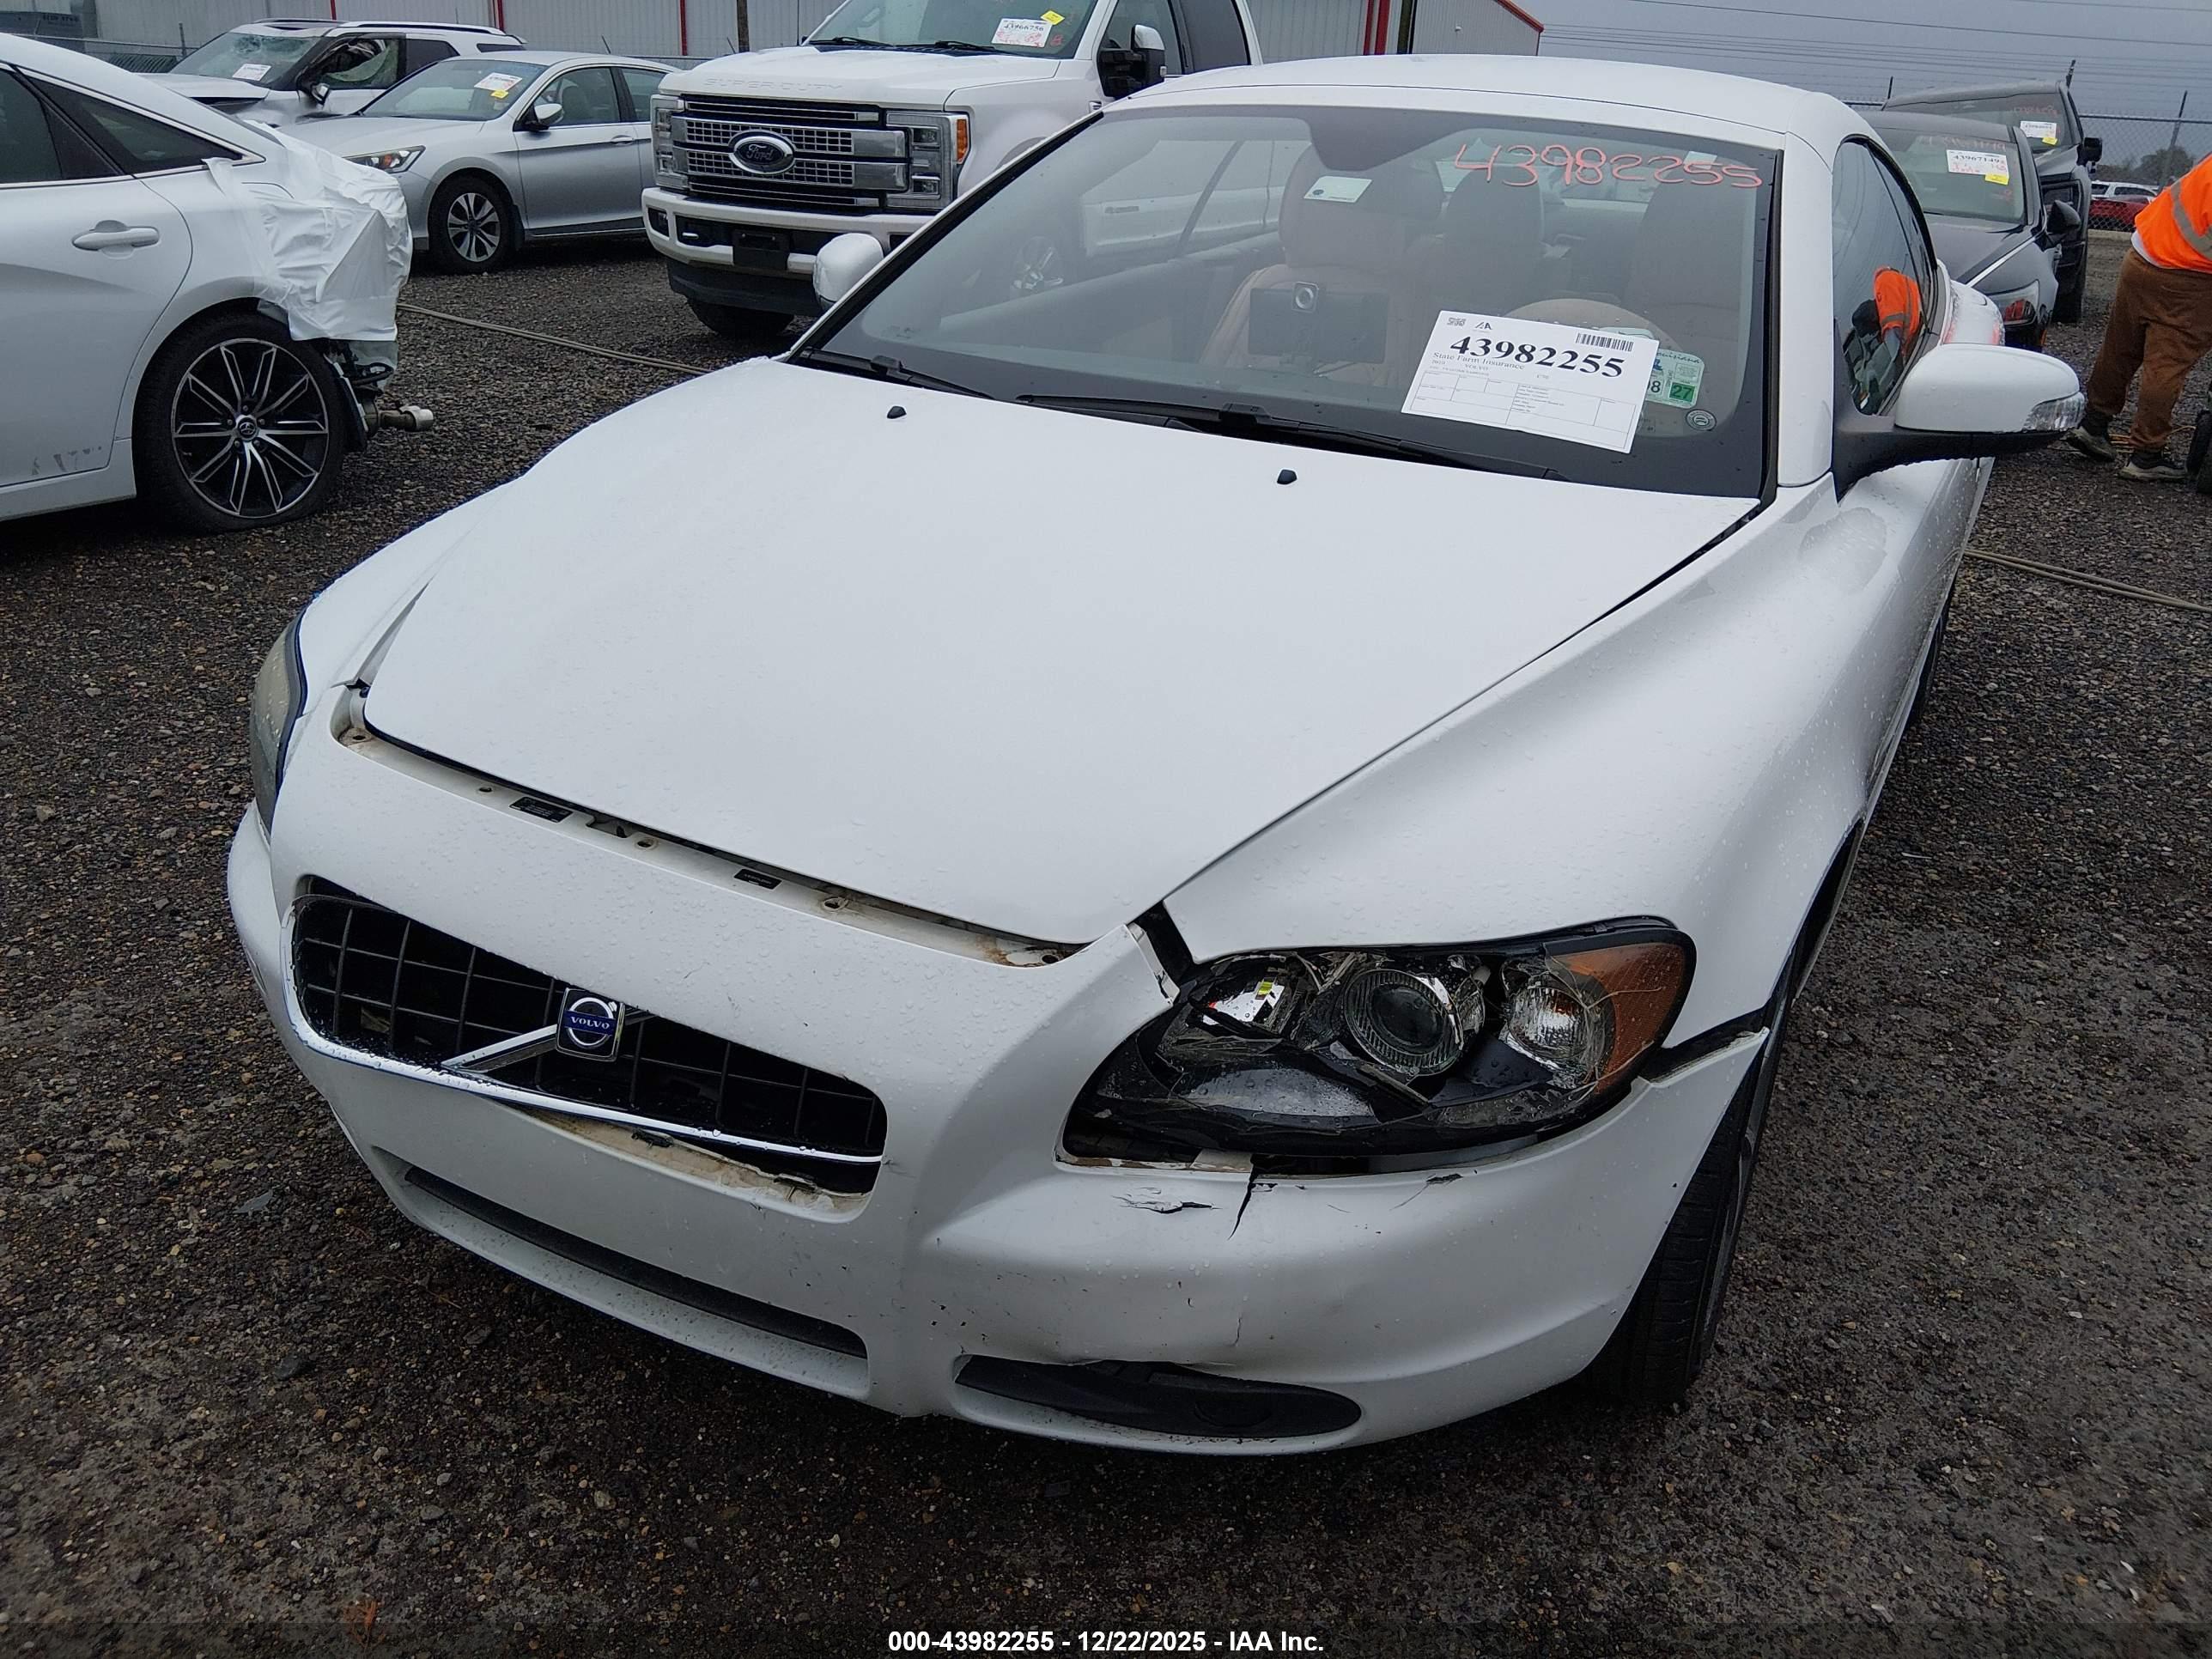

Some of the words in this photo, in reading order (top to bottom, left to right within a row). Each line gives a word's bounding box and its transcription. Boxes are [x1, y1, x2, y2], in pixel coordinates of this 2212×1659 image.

[746, 143, 773, 161] Ford
[1455, 143, 1763, 188] 43982255
[1432, 351, 1455, 361] State
[1456, 354, 1480, 364] Farm
[1481, 357, 1525, 370] Insurance
[1449, 336, 1626, 379] 43982255
[1656, 350, 1700, 364] ouisiana
[1670, 384, 1692, 399] 27
[570, 1016, 611, 1030] VOLVO
